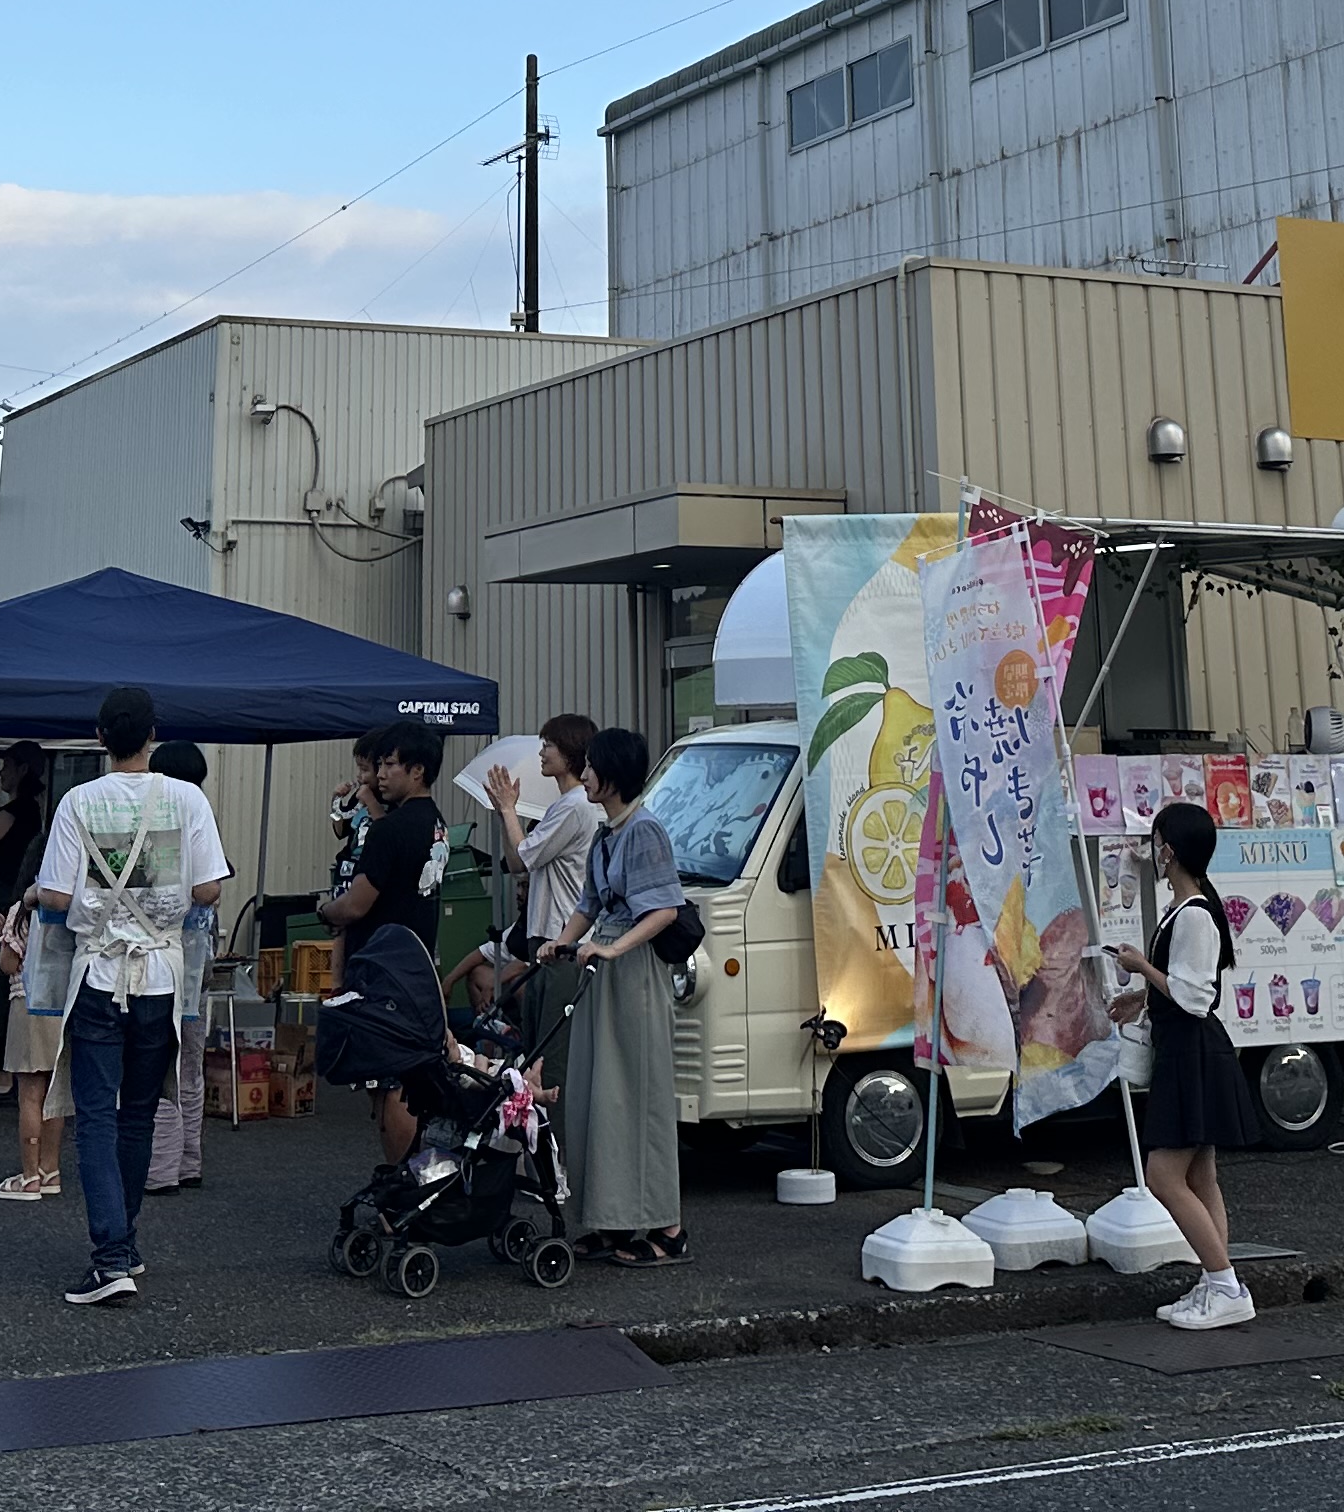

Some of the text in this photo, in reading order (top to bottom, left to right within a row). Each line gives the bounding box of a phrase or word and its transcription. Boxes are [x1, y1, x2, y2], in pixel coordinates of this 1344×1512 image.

[398, 700, 481, 715] CAPTAIN STAG
[1238, 840, 1309, 865] MENU
